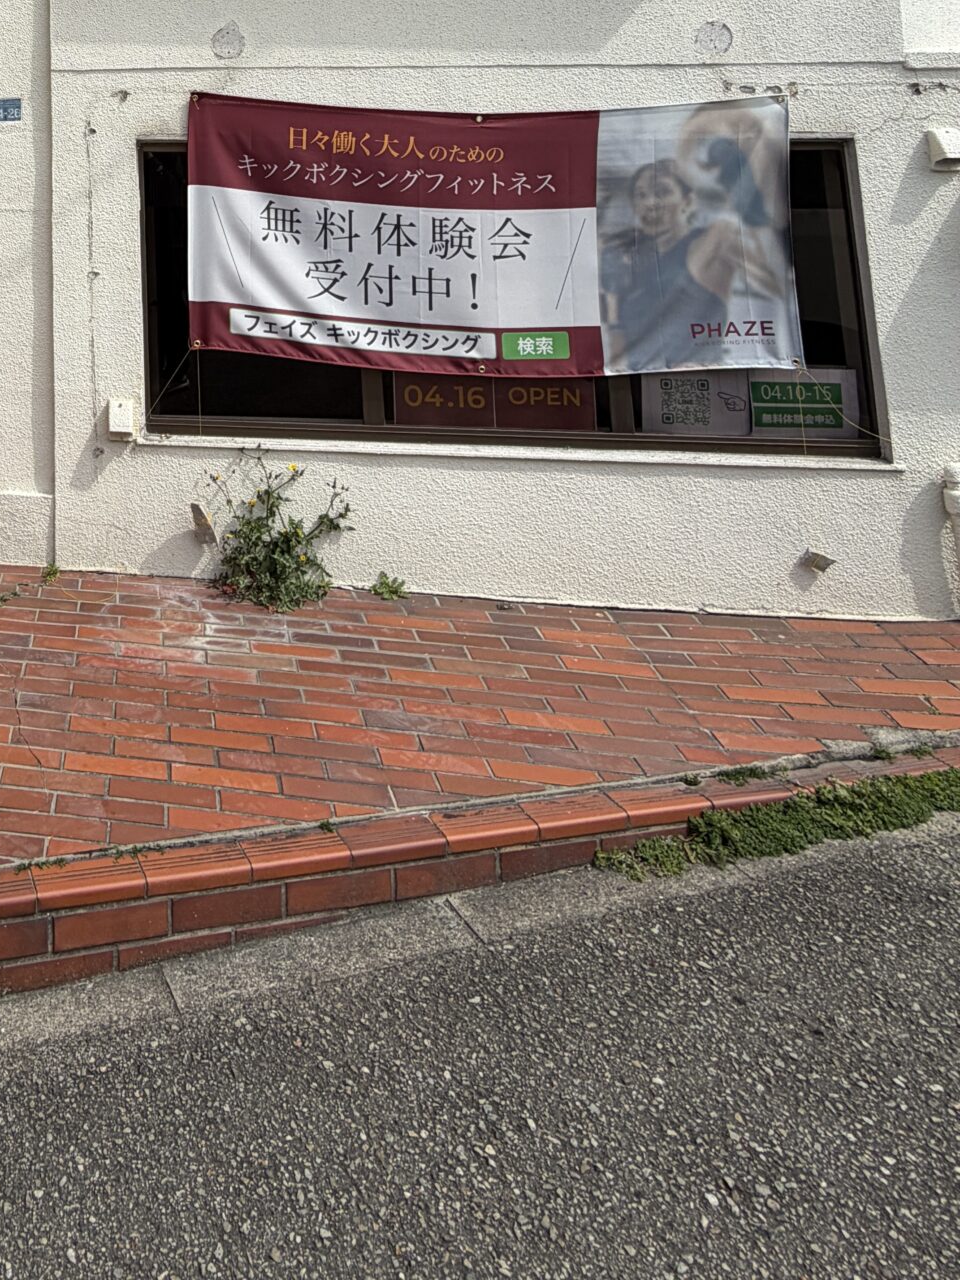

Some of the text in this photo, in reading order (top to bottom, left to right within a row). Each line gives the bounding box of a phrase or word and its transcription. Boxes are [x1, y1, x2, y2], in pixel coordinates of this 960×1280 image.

[288, 126, 505, 164] 日々働く大人のための
[238, 153, 557, 195] キックボクシングフィットネス
[259, 200, 533, 261] 無料体験会
[305, 258, 479, 311] 受付中！
[243, 314, 482, 354] フェイズ キックボクシング
[517, 336, 554, 356] 検索
[690, 320, 776, 339] PHAZE
[403, 384, 581, 409] 04.16 OPEN
[760, 384, 832, 401] 04.10-15
